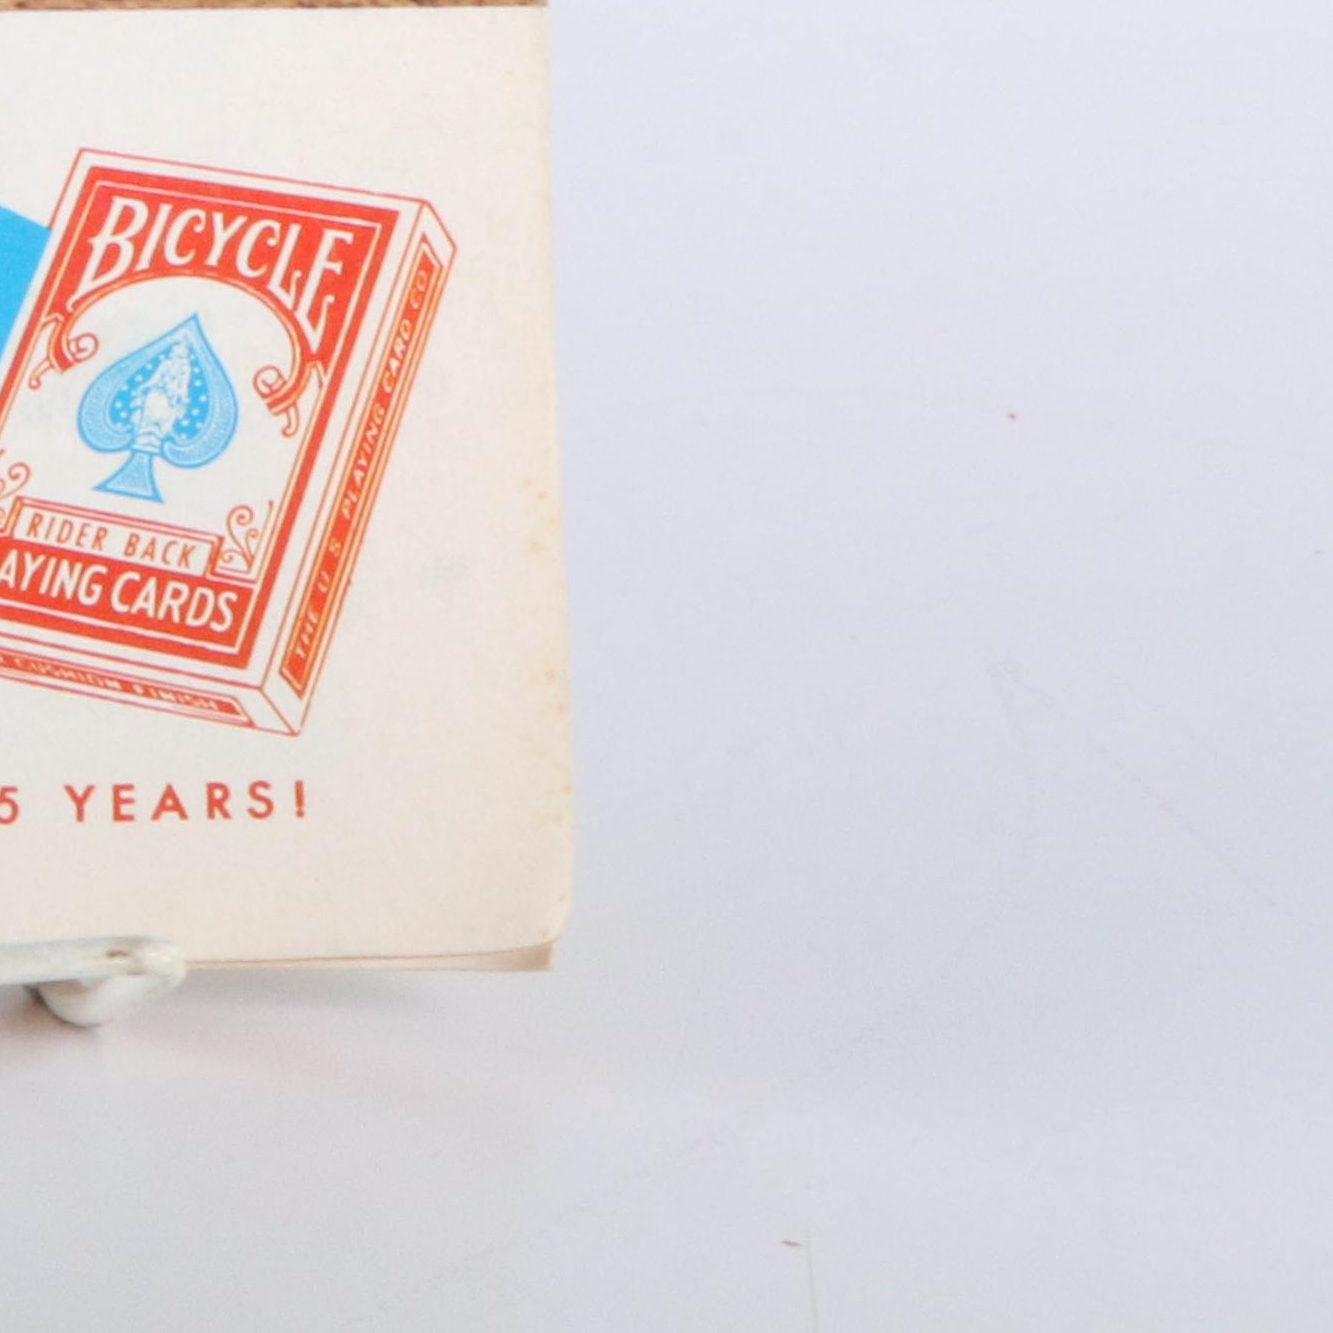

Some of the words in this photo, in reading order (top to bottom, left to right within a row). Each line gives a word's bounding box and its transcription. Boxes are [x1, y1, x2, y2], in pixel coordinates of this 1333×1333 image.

[65, 195, 356, 353] BICYCLE
[340, 402, 384, 521] PLAYING
[381, 318, 413, 394] CARD
[25, 512, 106, 551] RIDER
[122, 532, 200, 570] BACK
[110, 574, 238, 633] CARDS
[64, 780, 308, 823] YEARS!
